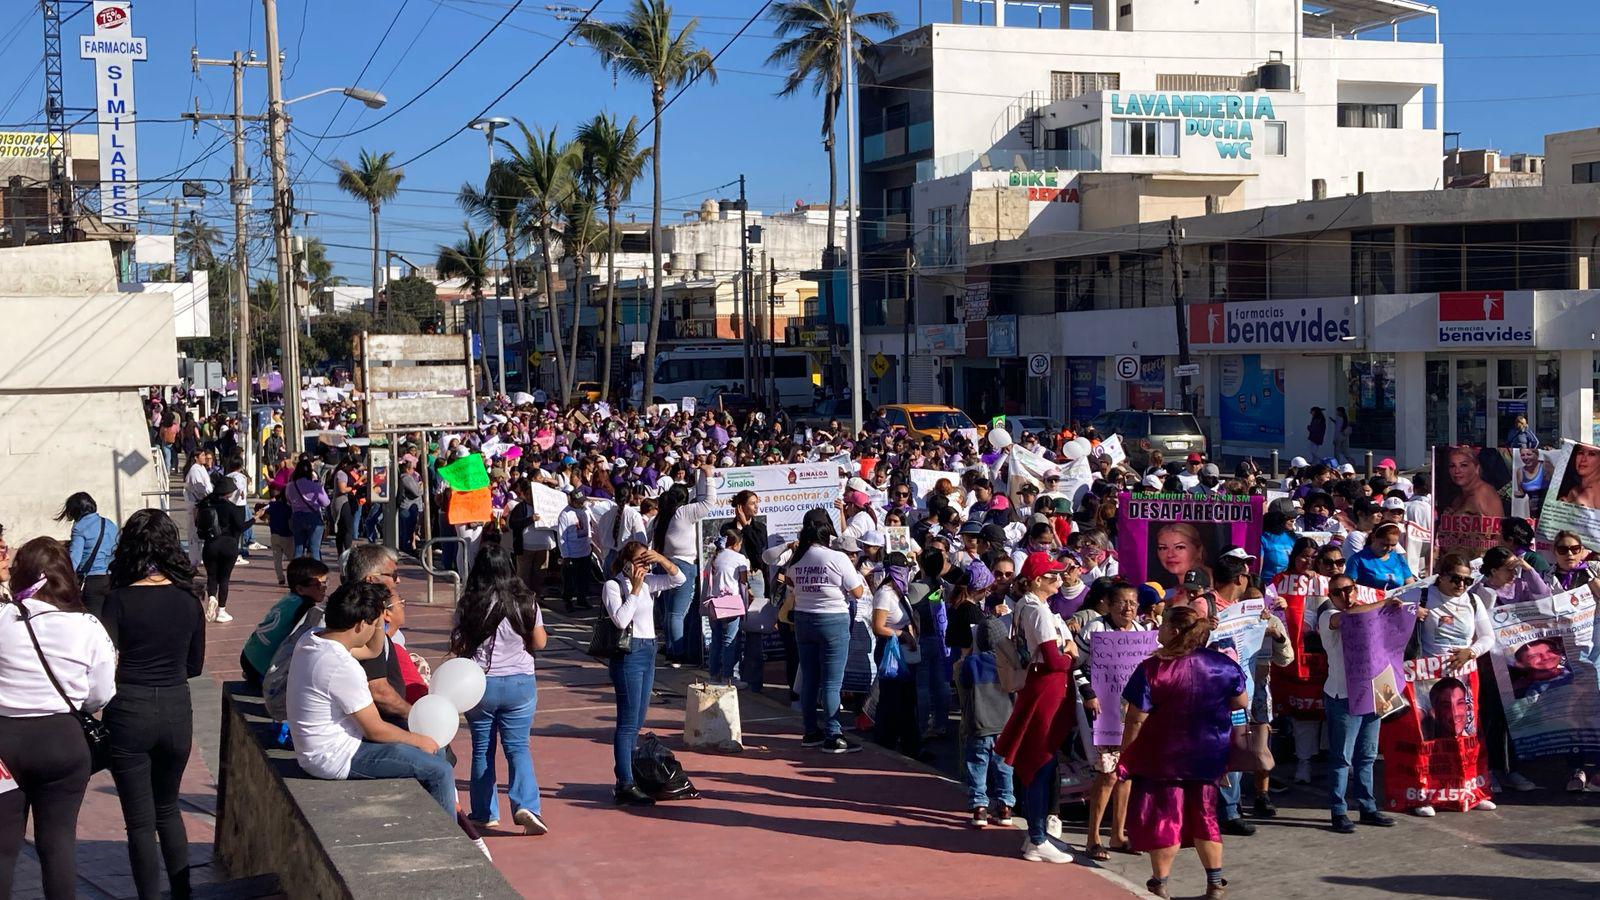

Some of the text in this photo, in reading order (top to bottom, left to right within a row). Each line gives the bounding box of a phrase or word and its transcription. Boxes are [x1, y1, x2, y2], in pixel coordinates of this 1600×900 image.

[100, 10, 121, 23] 75%
[84, 40, 143, 54] FARMACIAS
[1111, 94, 1276, 120] LAVANDERIA
[1185, 119, 1253, 140] DUCHA
[107, 66, 128, 216] SIMILARES
[1215, 141, 1252, 160] WC
[1009, 172, 1058, 187] BIKE
[1028, 187, 1080, 203] RENTA
[1235, 306, 1284, 319] farmacias
[1227, 307, 1350, 343] benavides
[1440, 326, 1532, 342] benavides
[1122, 361, 1133, 374] E
[727, 479, 755, 489] Sinaloa
[773, 491, 820, 503] encontrar
[760, 504, 795, 514] VERDUGO
[797, 501, 833, 511] CERVANTE
[1129, 502, 1253, 522] DESAPARECIDA
